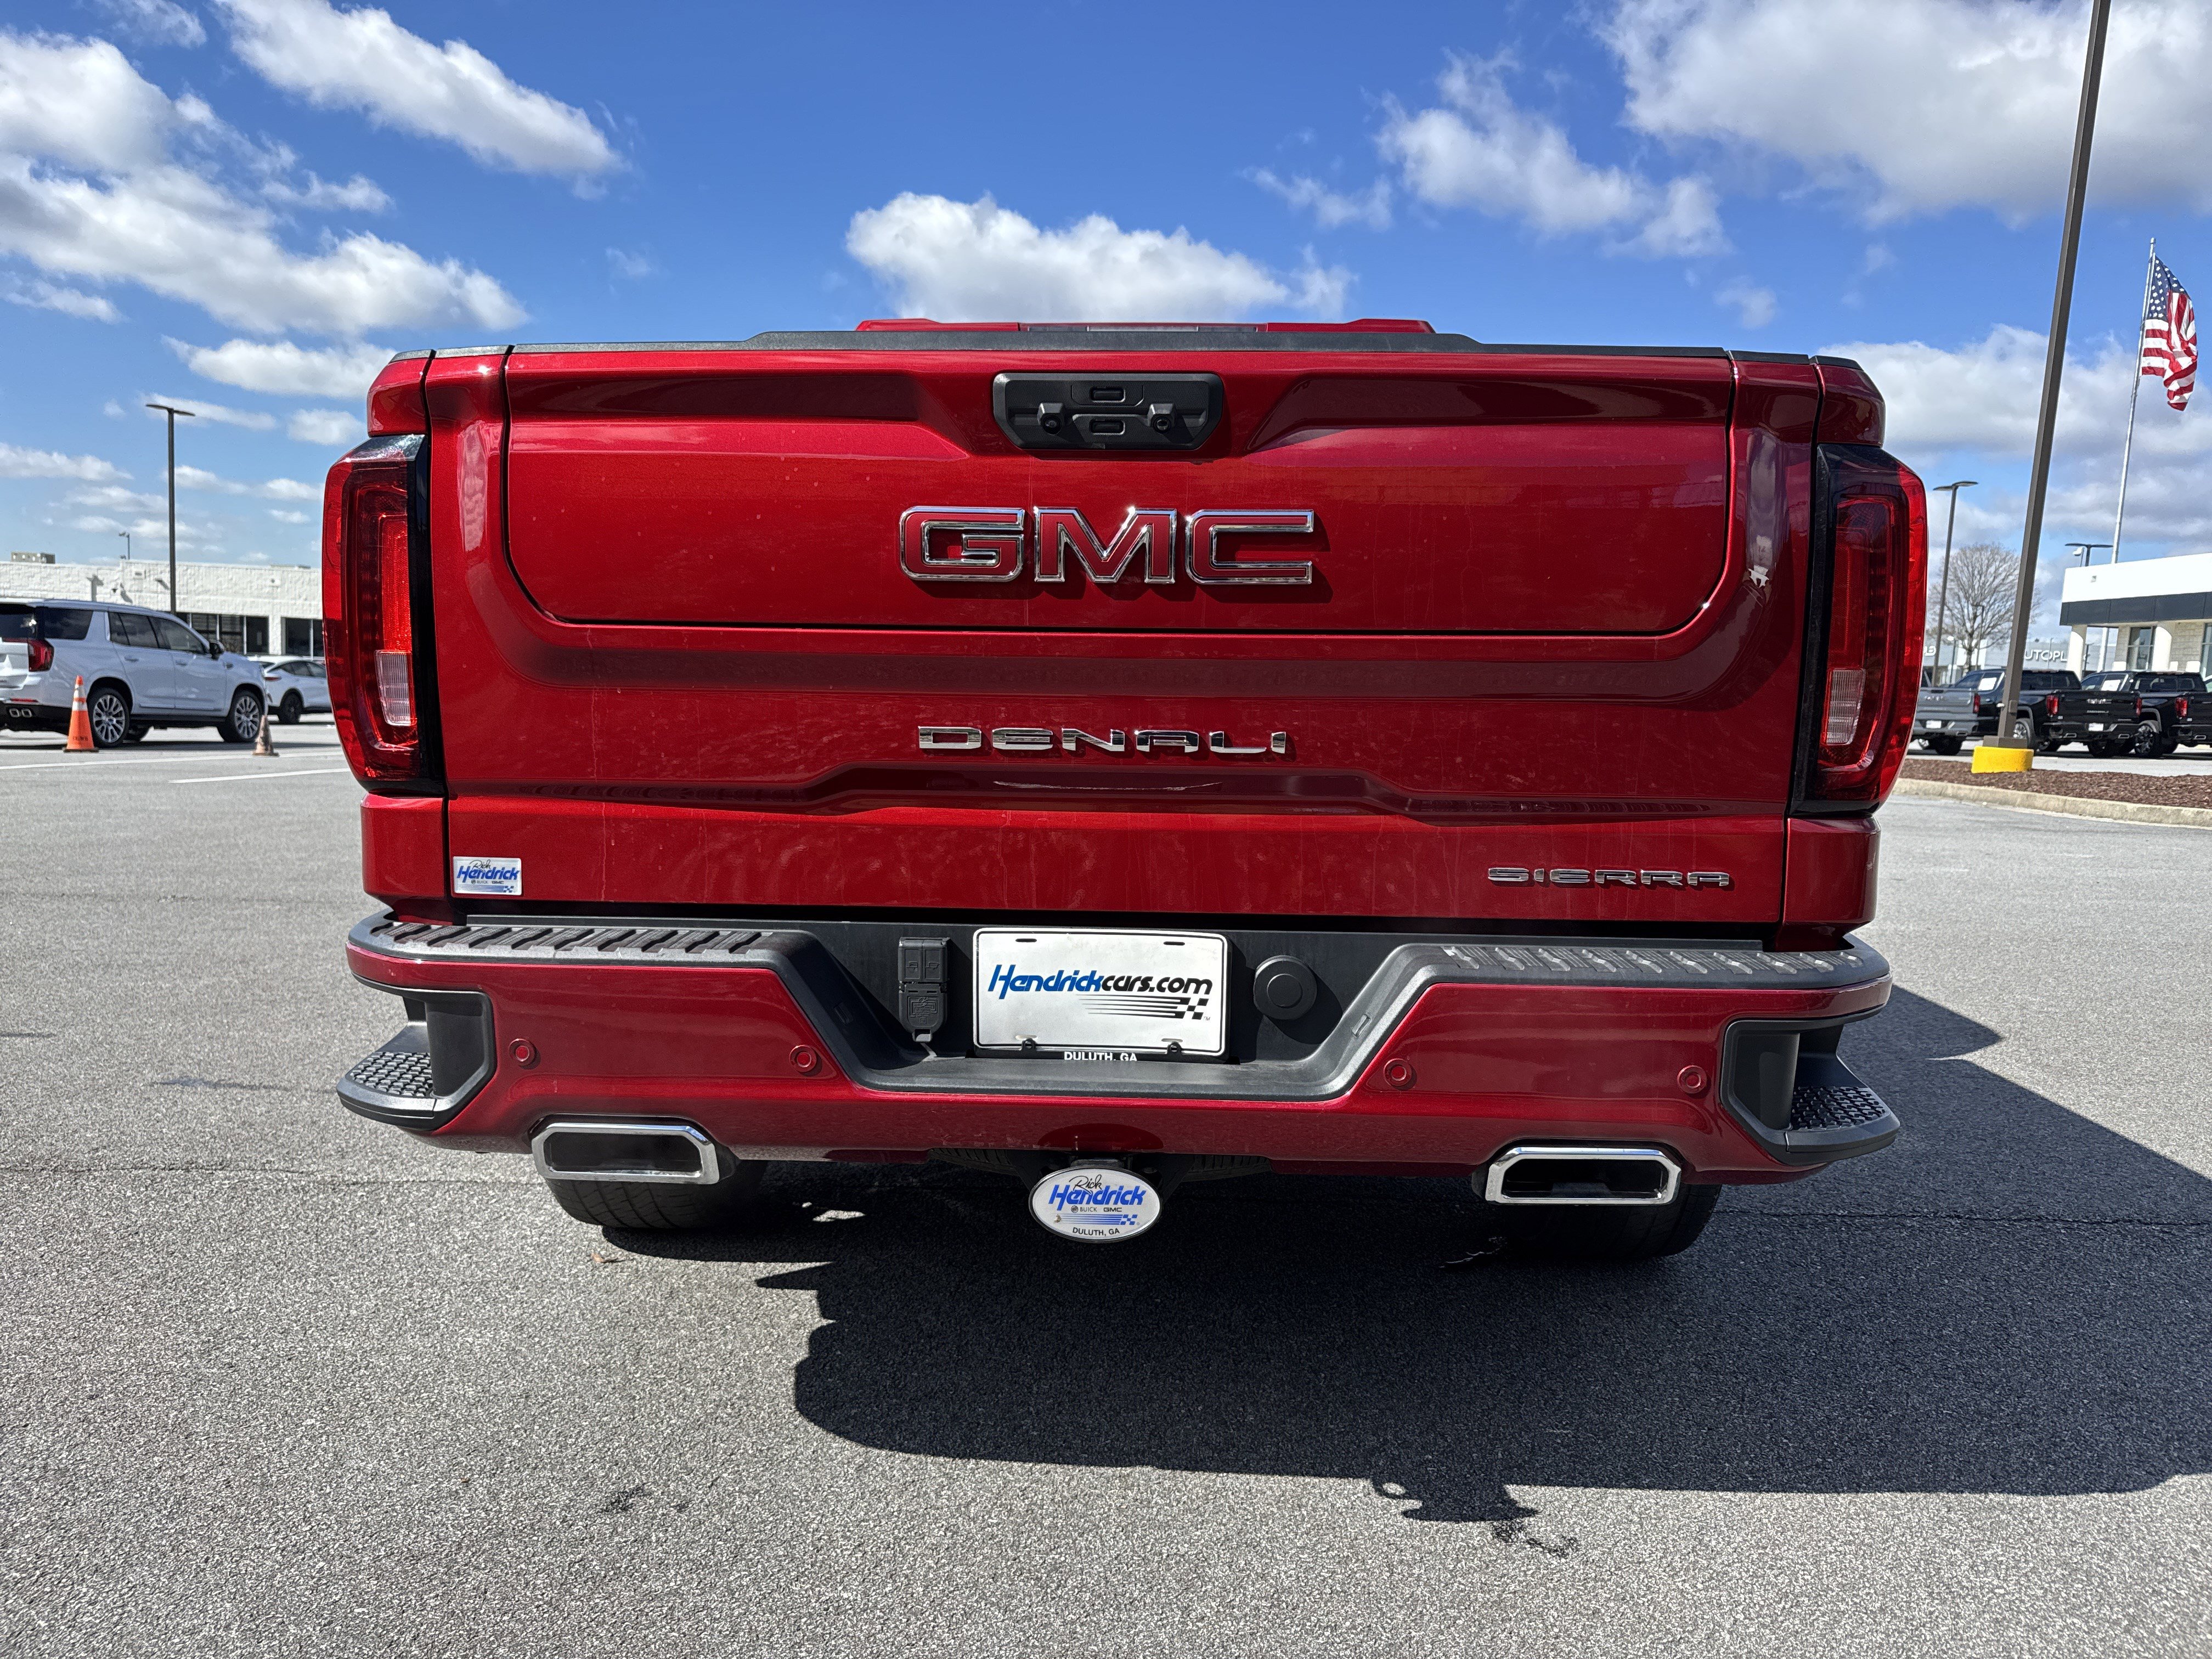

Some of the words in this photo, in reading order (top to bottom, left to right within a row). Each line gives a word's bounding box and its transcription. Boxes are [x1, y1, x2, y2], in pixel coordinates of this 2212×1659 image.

[899, 506, 1314, 584] GMC
[2024, 649, 2068, 662] UTOPL
[918, 726, 1286, 754] DENALI
[457, 865, 520, 883] Hendrick
[469, 859, 491, 872] Rick
[1487, 867, 1730, 887] SIERRA
[988, 964, 1213, 1000] Hendrickcars.com
[1120, 1052, 1137, 1062] GA
[1069, 1174, 1103, 1194] Rick
[1048, 1184, 1147, 1211] Hendrick
[1073, 1227, 1107, 1237] DULUTH,
